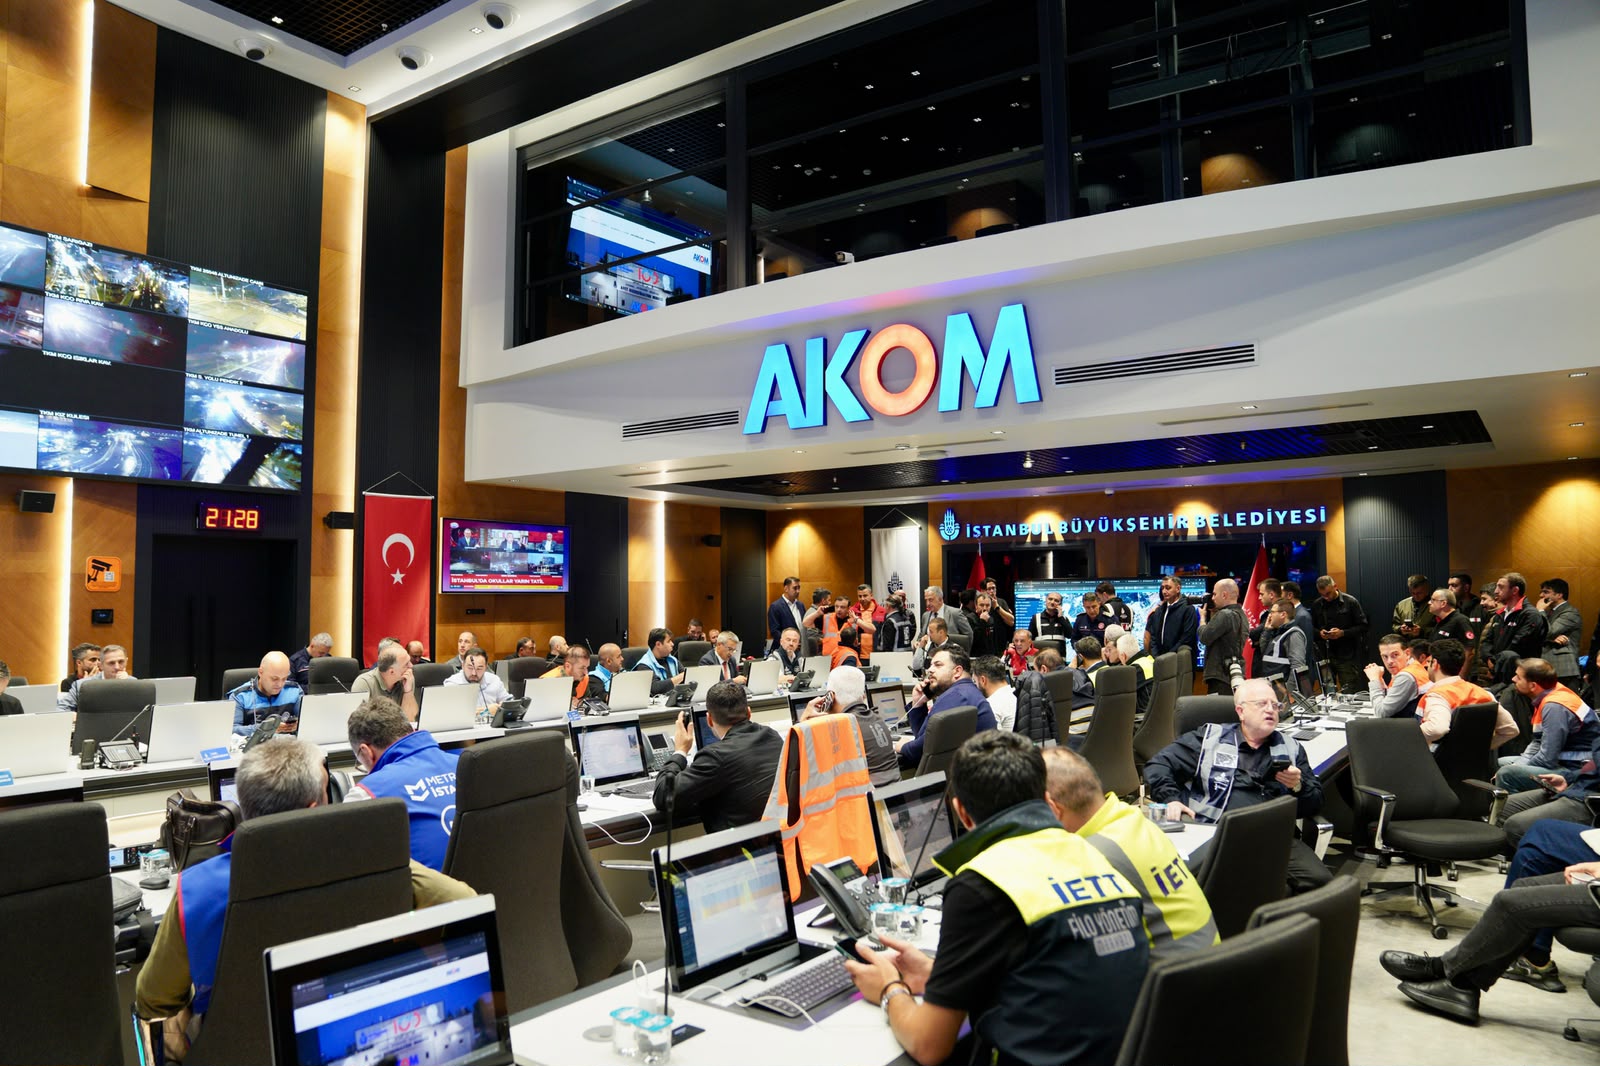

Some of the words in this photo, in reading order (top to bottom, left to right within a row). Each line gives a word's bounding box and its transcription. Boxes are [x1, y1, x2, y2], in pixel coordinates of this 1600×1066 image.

[743, 303, 1043, 435] AKOM
[966, 522, 1054, 539] İSTANBUL
[1058, 512, 1189, 534] BÜYÜKŞEHİR
[1195, 506, 1326, 529] BELEDİYESİ
[425, 772, 456, 787] METR
[1047, 874, 1124, 905] İETT
[1150, 853, 1187, 896] İET
[1067, 912, 1098, 940] FİLO
